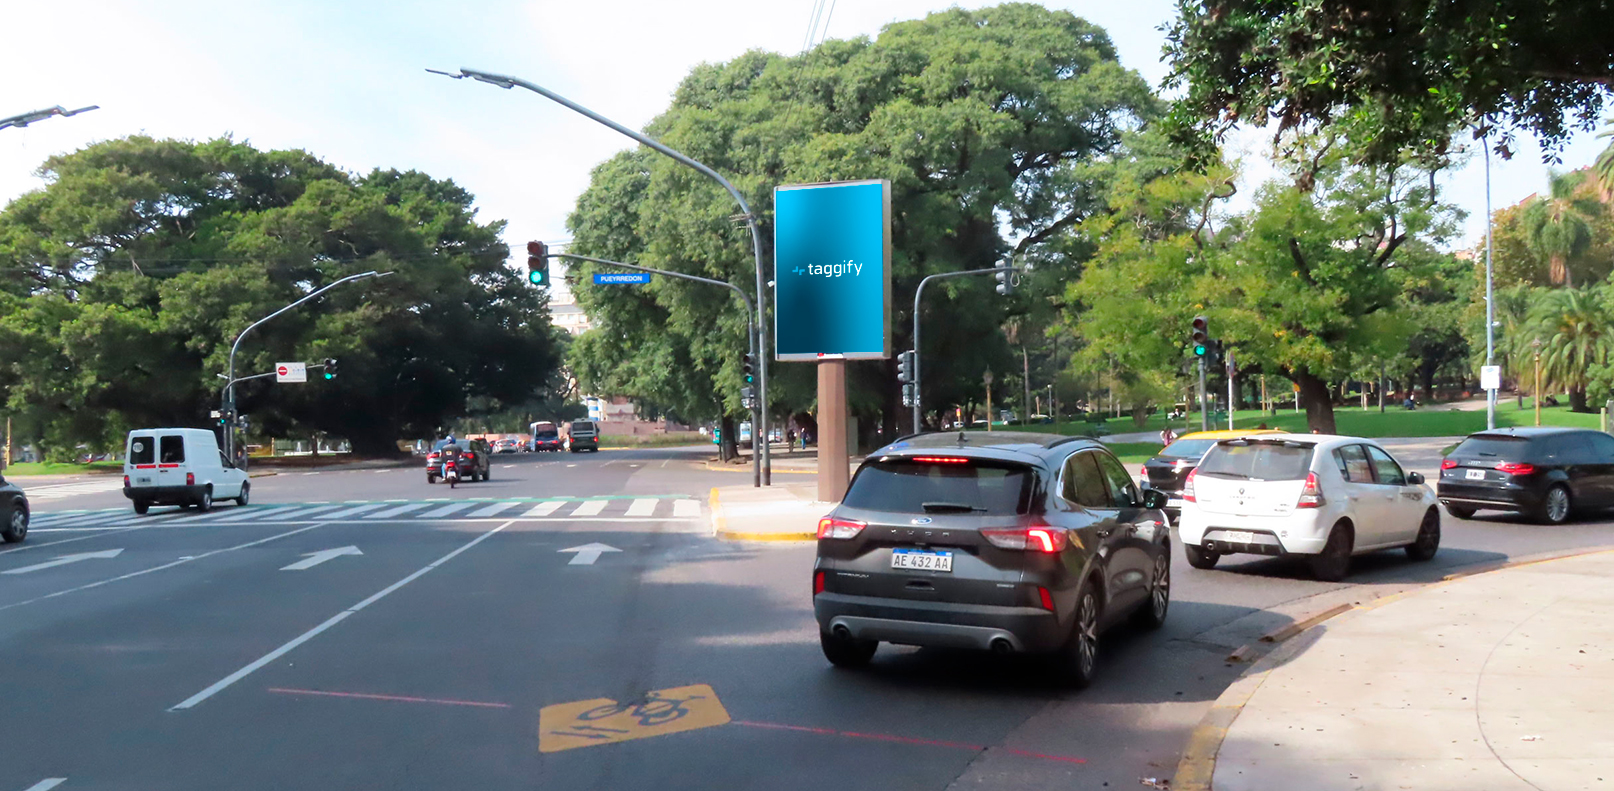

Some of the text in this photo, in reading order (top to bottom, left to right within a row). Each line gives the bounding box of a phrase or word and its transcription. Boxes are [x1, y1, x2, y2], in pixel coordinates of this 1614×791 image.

[808, 260, 863, 277] taggify
[894, 555, 948, 569] AE 432 AA
